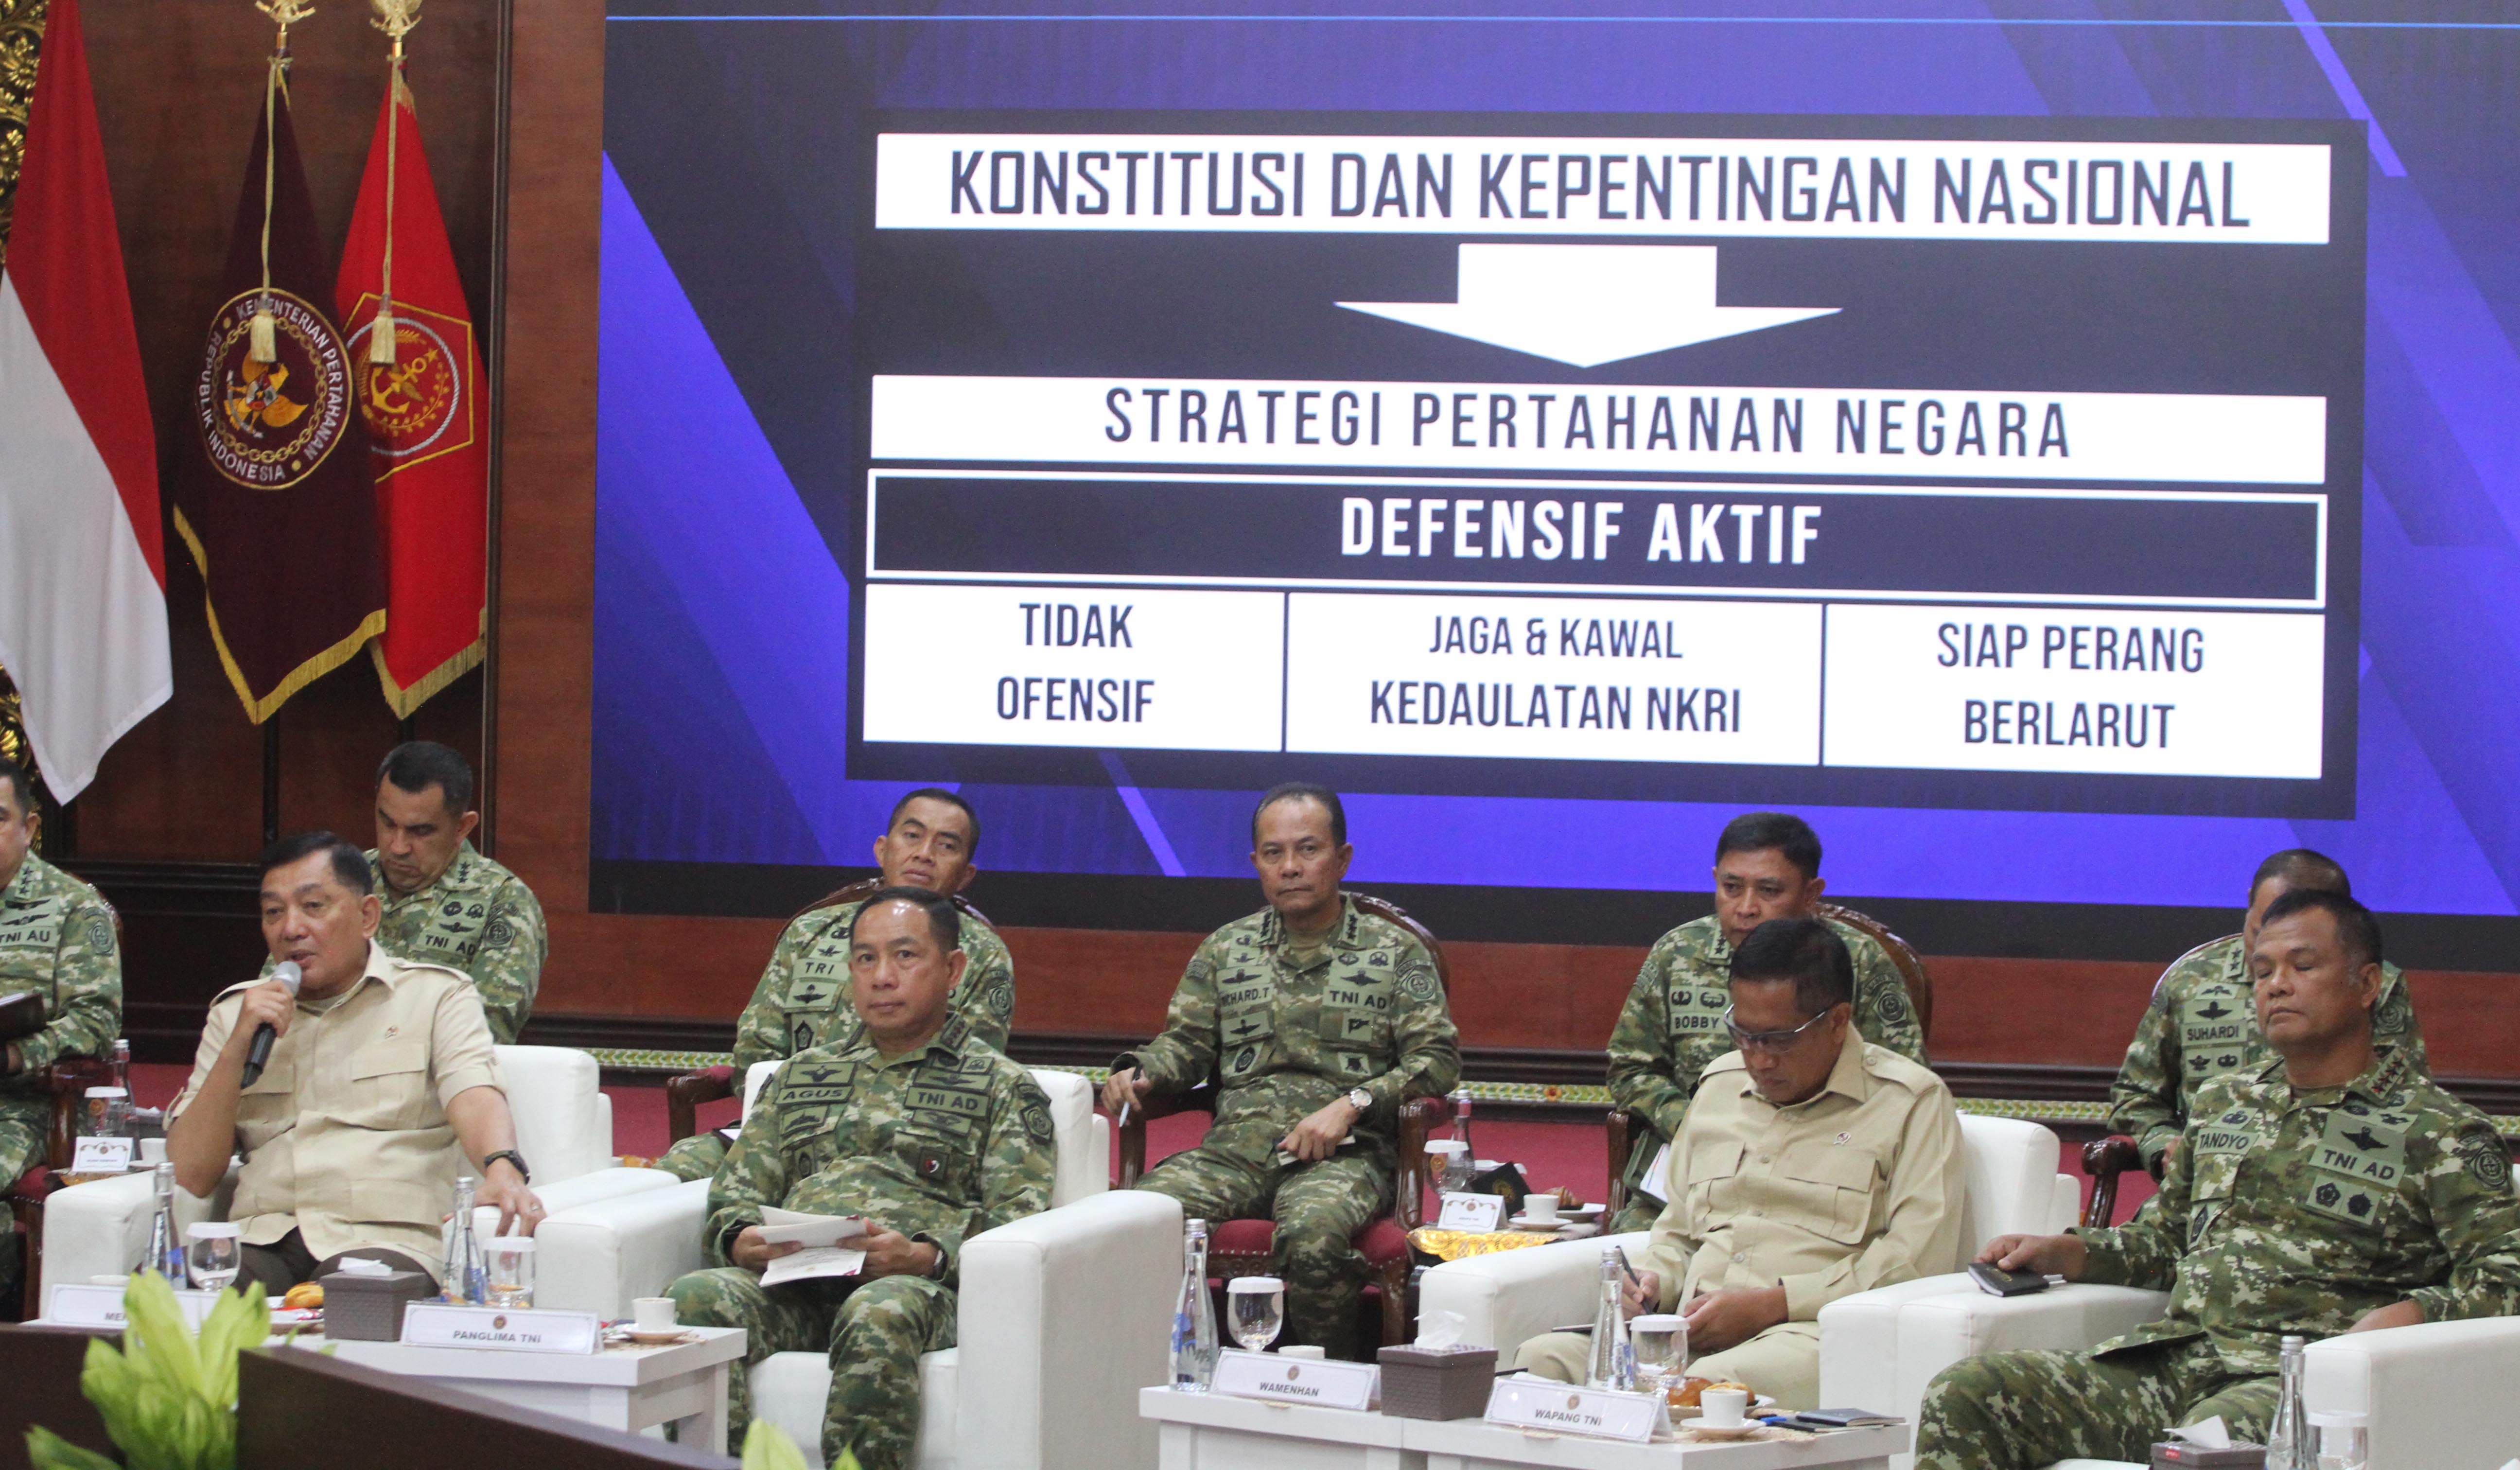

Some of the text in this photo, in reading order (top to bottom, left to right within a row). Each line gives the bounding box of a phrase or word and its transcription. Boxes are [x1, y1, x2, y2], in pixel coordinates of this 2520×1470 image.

[951, 151, 2249, 227] KONSTITUSI DAN KEPENTINGAN NASIONAL
[199, 331, 286, 482] REPUBLIK INDONESIA
[304, 347, 343, 461] PERTAHANAN
[1106, 388, 2068, 457] STRATEGI PERTAHANAN NEGARA
[1342, 498, 1821, 563] DEFENSIF AKTIF
[1020, 604, 1132, 648] TIDAK
[1430, 616, 1682, 658] JAGA & KAWAL
[1938, 623, 2203, 672] SIAP PERANG
[998, 677, 1154, 722] OFENSIF
[1372, 681, 1739, 732] KEDAULATAN NKRI
[1965, 700, 2174, 748] BERLARUT
[26, 930, 51, 942] AU
[426, 935, 476, 955] TNI AD
[806, 962, 834, 974] TRI
[1330, 991, 1386, 1009] TNI AD
[1675, 1016, 1719, 1029] BOBBY
[2188, 1025, 2239, 1040] SUHARDI
[783, 1090, 842, 1100] AGUS
[918, 1092, 978, 1110] TNI AD
[2200, 1133, 2249, 1149] TANDYO
[2325, 1149, 2394, 1179] TNI AD
[453, 1330, 542, 1343] PANGLIMA TNI
[1260, 1382, 1319, 1397] WAMENHAN
[1535, 1410, 1602, 1426] WAPANG TNI
